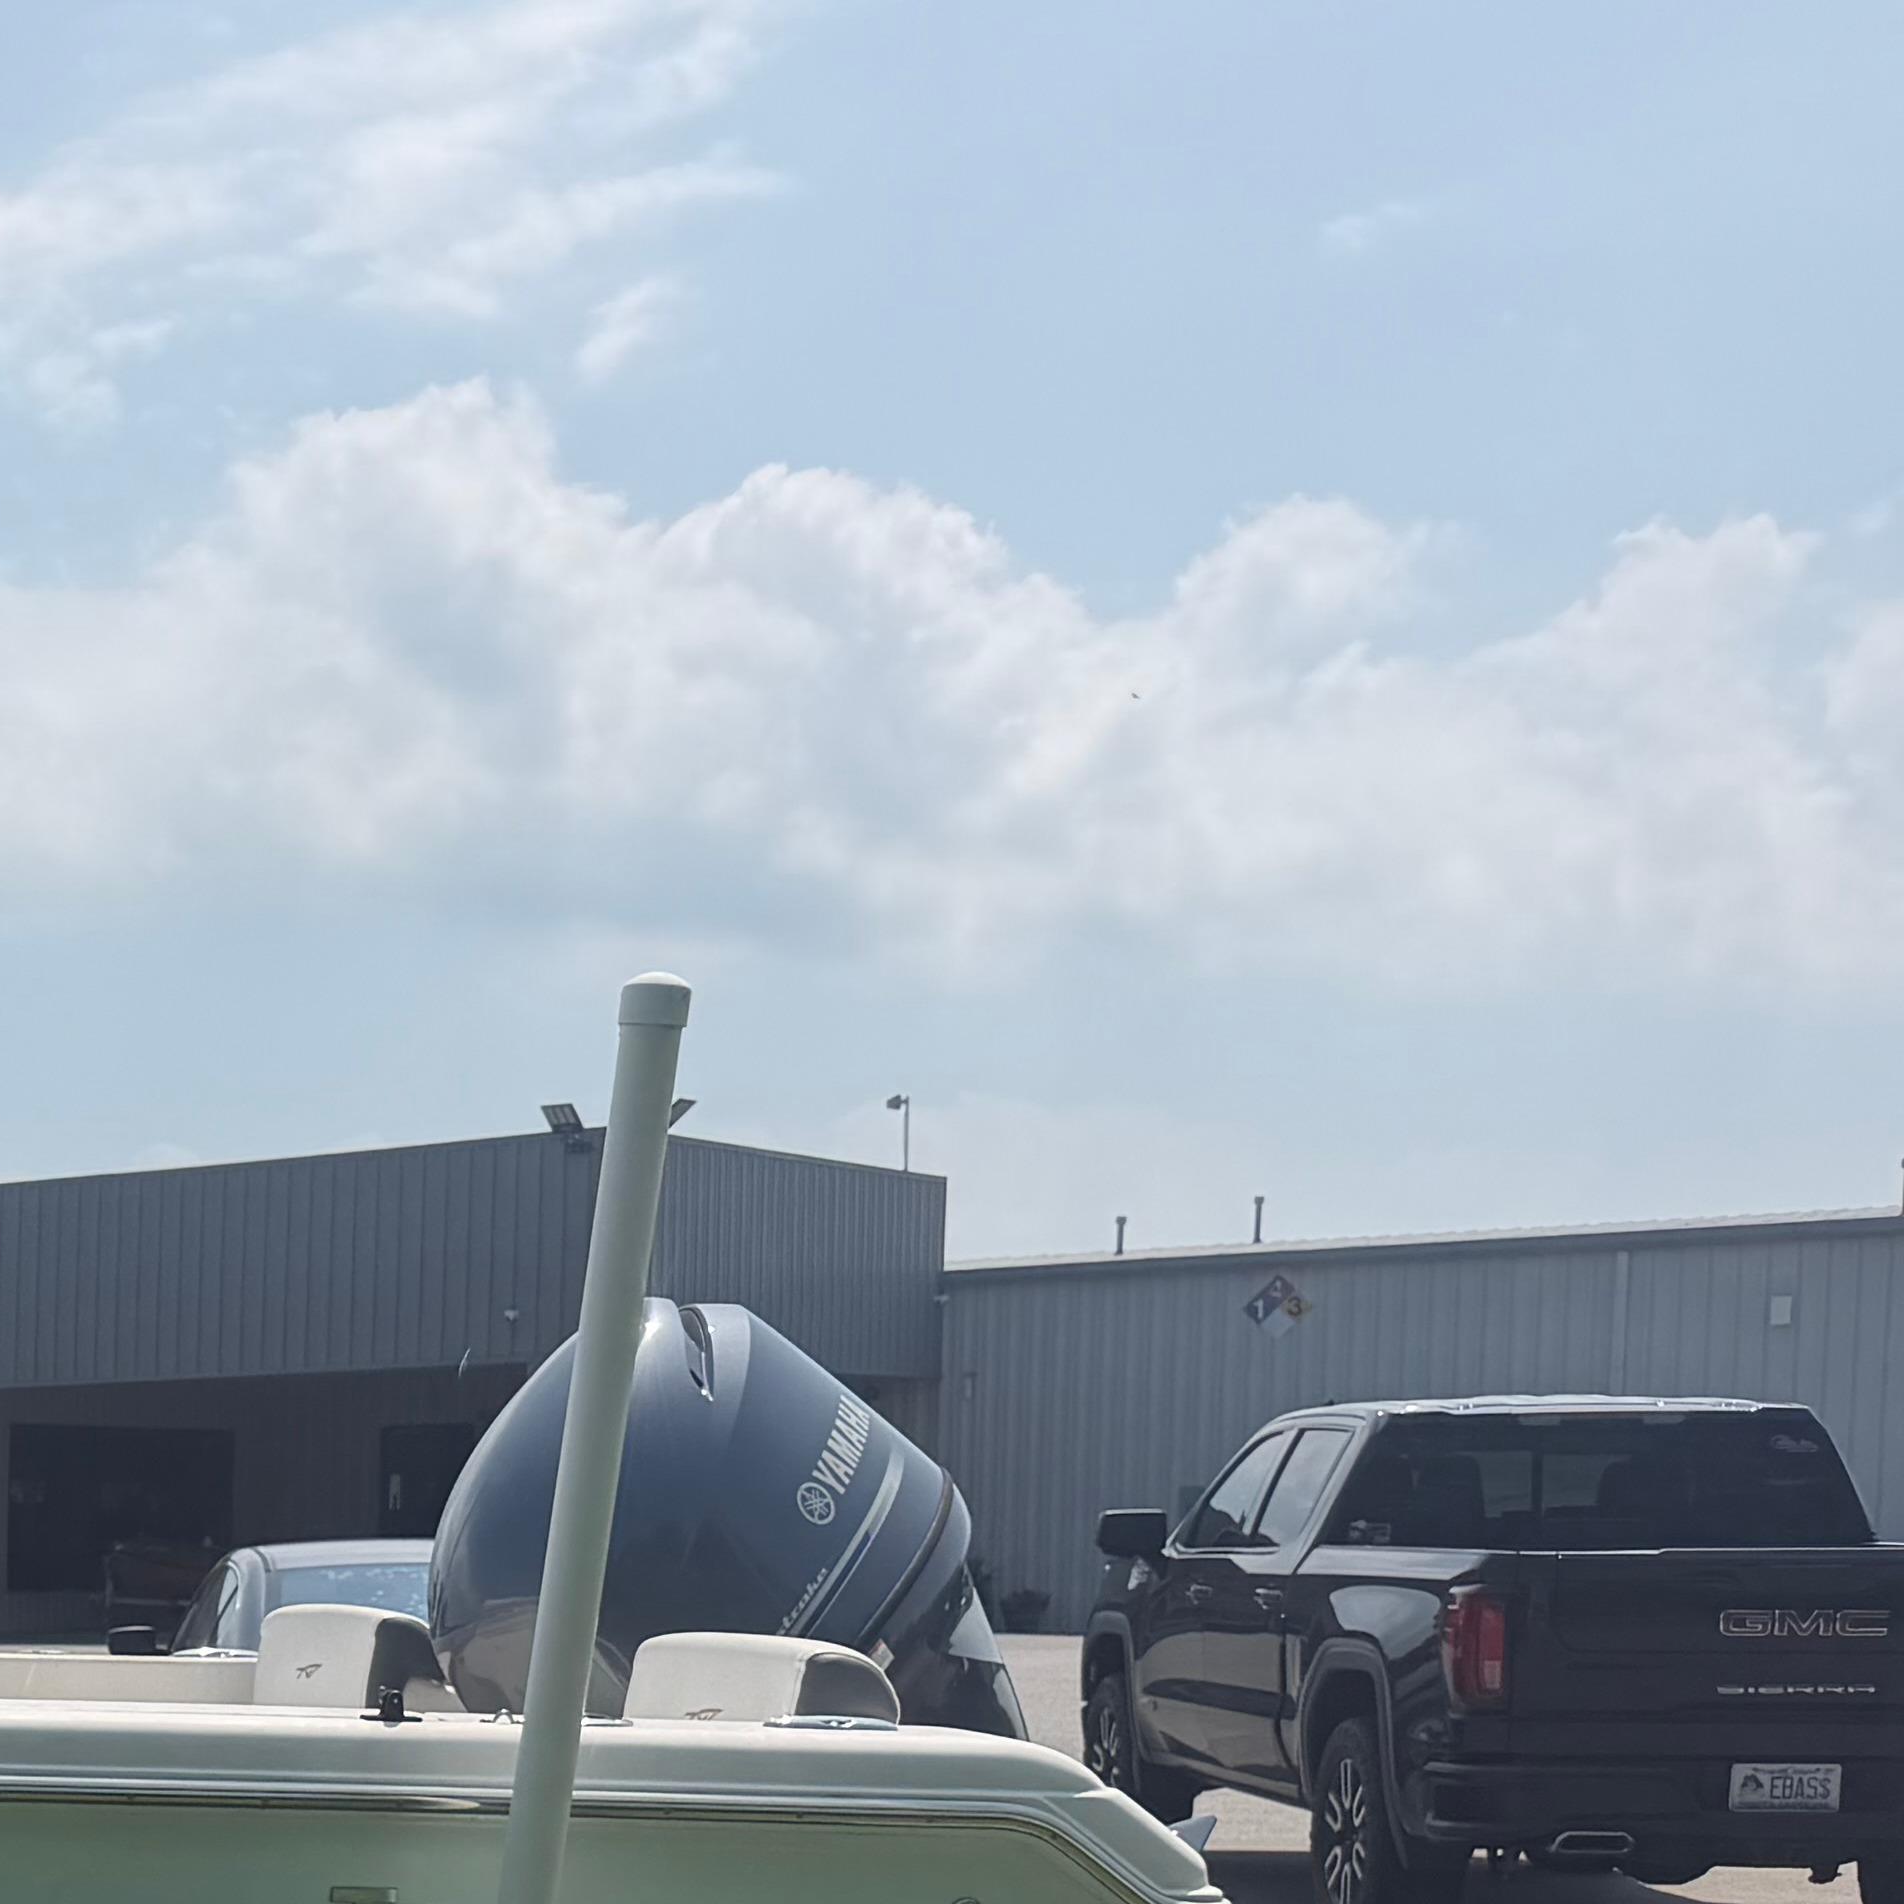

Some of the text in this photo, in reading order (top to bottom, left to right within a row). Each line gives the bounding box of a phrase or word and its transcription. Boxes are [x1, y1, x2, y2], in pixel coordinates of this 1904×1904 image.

[1252, 1299, 1264, 1319] 1
[1287, 1296, 1302, 1317] 3
[812, 1394, 872, 1495] YAMAHA
[1719, 1608, 1892, 1637] GMC
